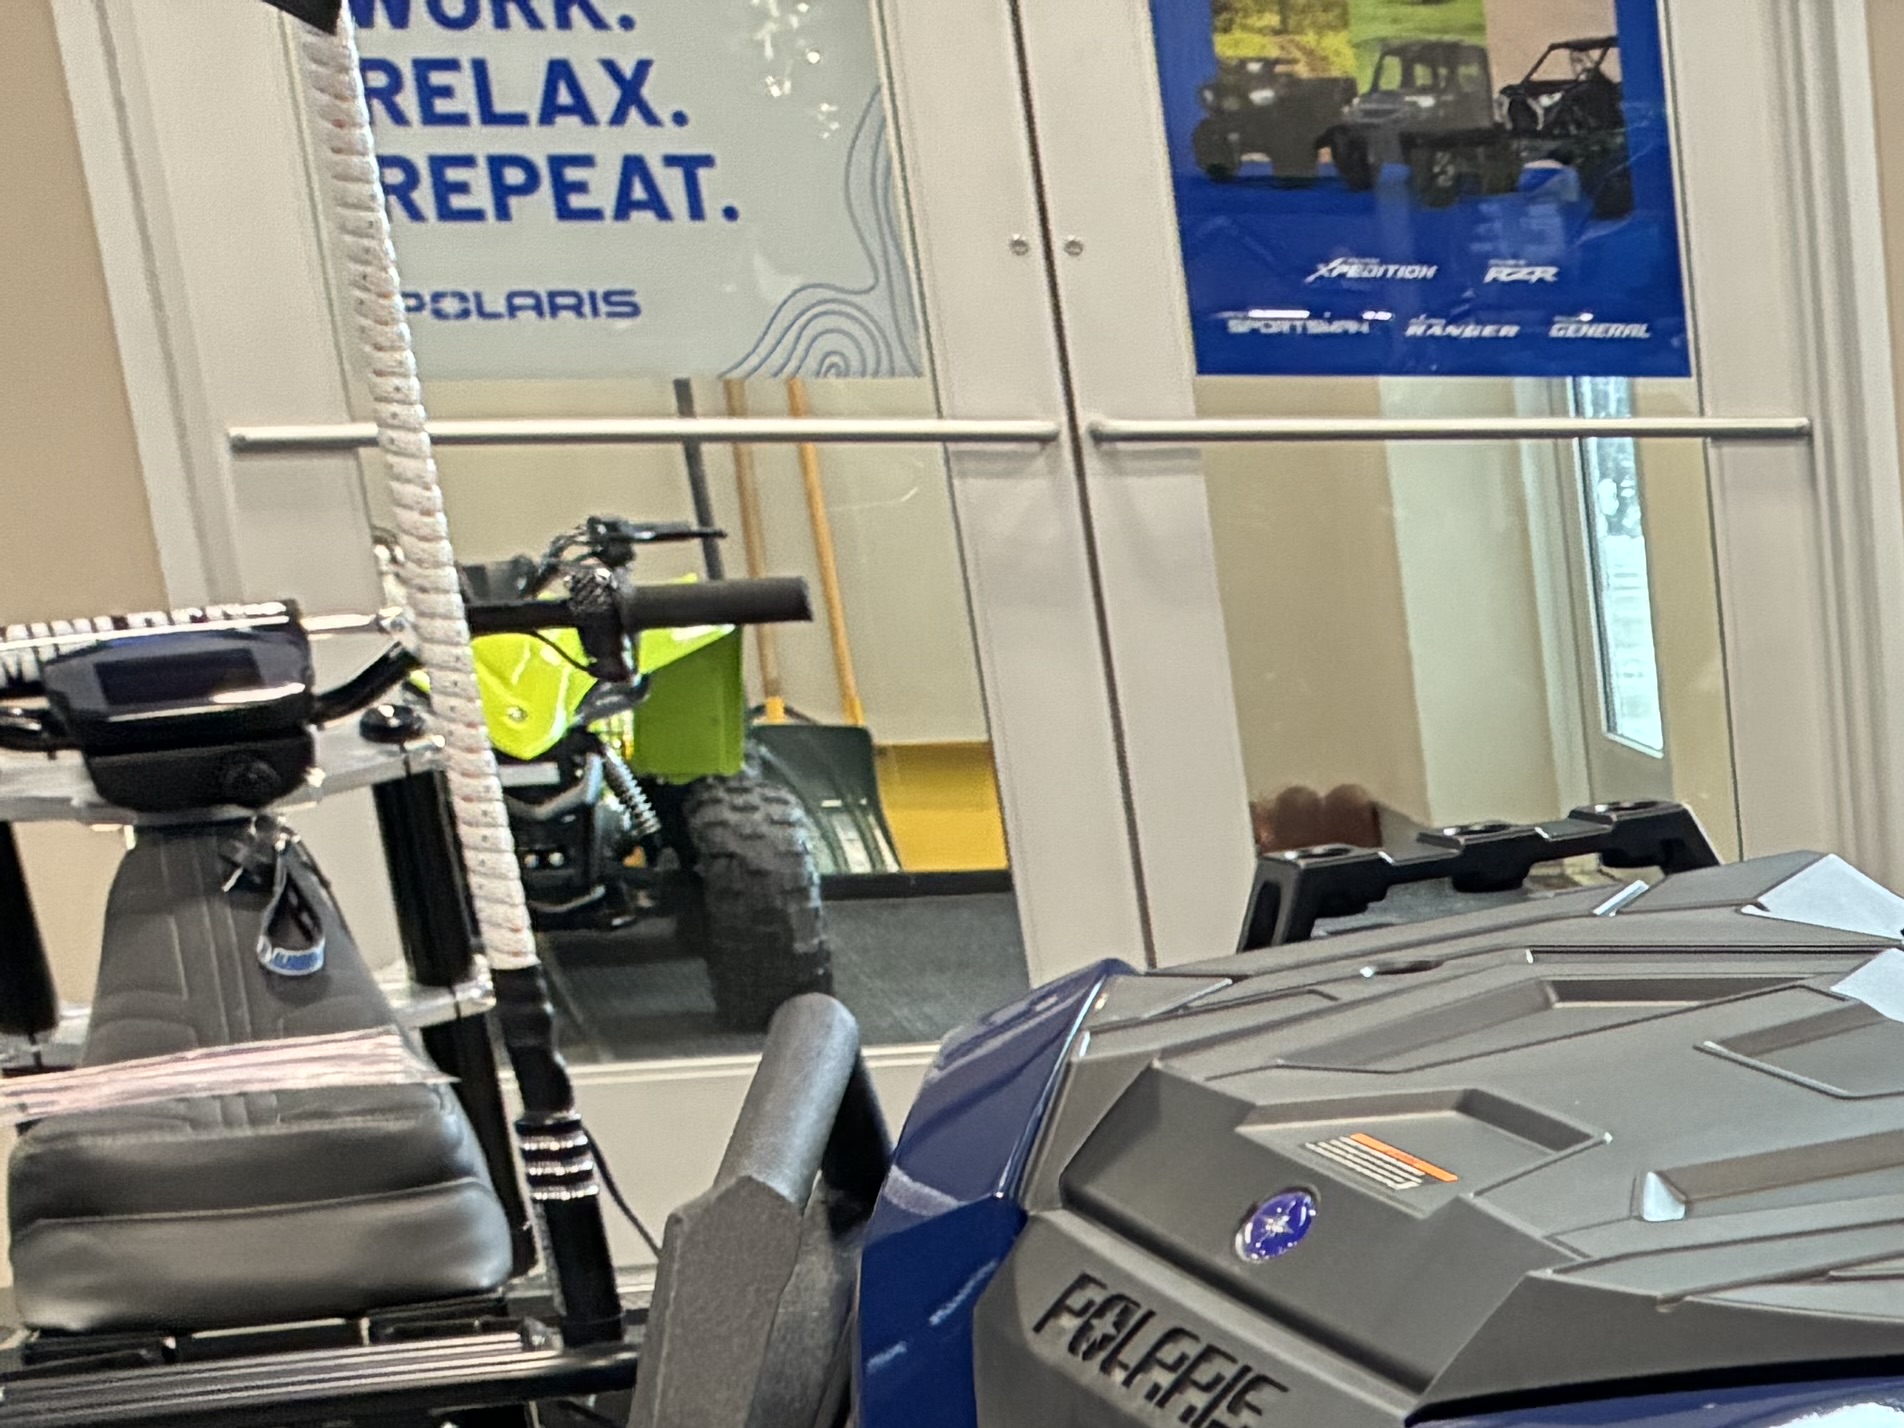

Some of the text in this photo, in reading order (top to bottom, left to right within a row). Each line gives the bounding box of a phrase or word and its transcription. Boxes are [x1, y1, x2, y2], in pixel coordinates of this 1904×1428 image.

[360, 57, 688, 127] RELAX.
[378, 154, 739, 222] REPEAT.
[401, 289, 641, 320] POLARIS
